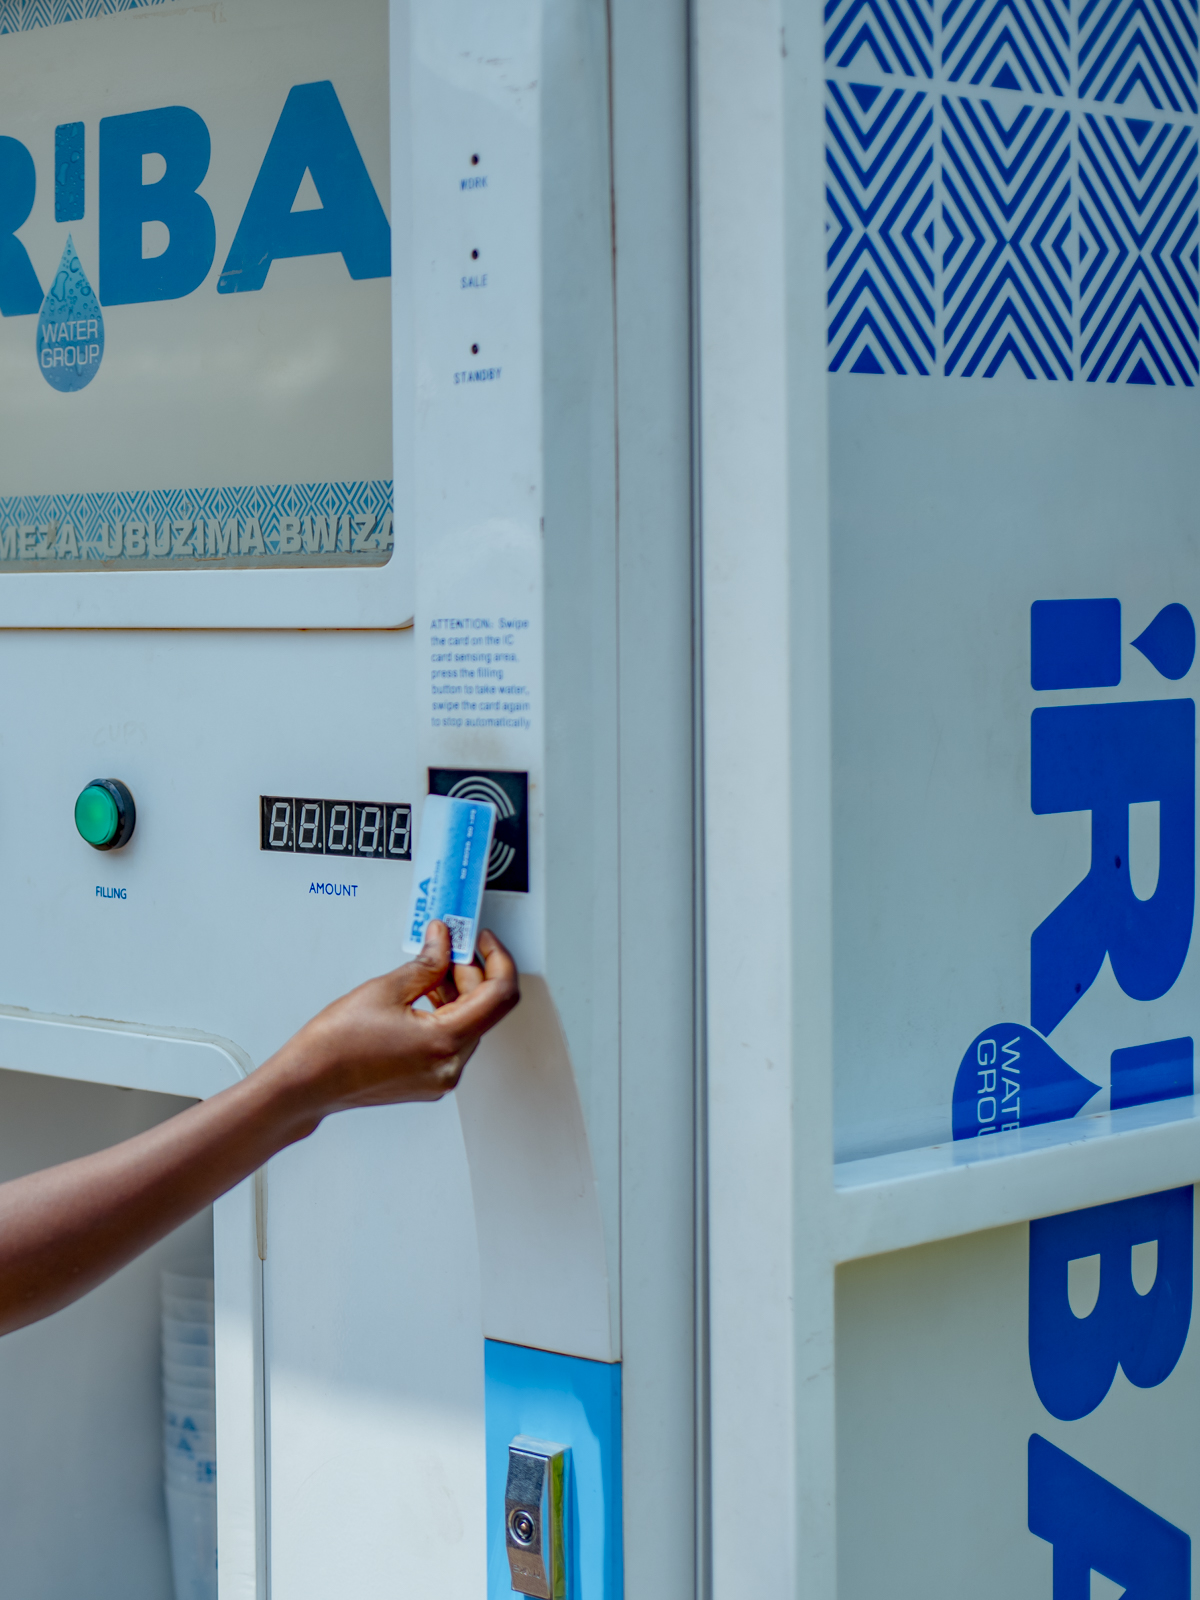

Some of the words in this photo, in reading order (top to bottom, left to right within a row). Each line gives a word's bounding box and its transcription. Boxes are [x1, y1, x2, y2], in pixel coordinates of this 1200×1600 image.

[460, 177, 488, 191] WORK
[461, 274, 488, 288] SALE
[42, 319, 98, 343] WATER
[41, 344, 99, 368] GROUP
[454, 367, 502, 385] STANDBY
[101, 516, 267, 558] UBUZIMA
[498, 618, 529, 630] Swipe
[430, 636, 446, 646] the
[448, 635, 469, 646] card
[471, 637, 483, 646] on
[484, 636, 500, 646] the
[431, 652, 452, 663] card
[455, 652, 492, 664] sensing
[431, 669, 458, 680] press
[460, 668, 475, 678] the
[476, 667, 504, 680] filling
[432, 685, 462, 695] button
[464, 685, 474, 695] to
[475, 685, 496, 695] take
[432, 702, 459, 712] swipe
[461, 701, 477, 711] the
[479, 701, 500, 711] card
[502, 702, 530, 713] again
[431, 717, 441, 727] to
[442, 717, 462, 729] stop
[464, 717, 531, 730] automatically
[95, 885, 127, 900] FILLING
[309, 882, 358, 897] AMOUNT
